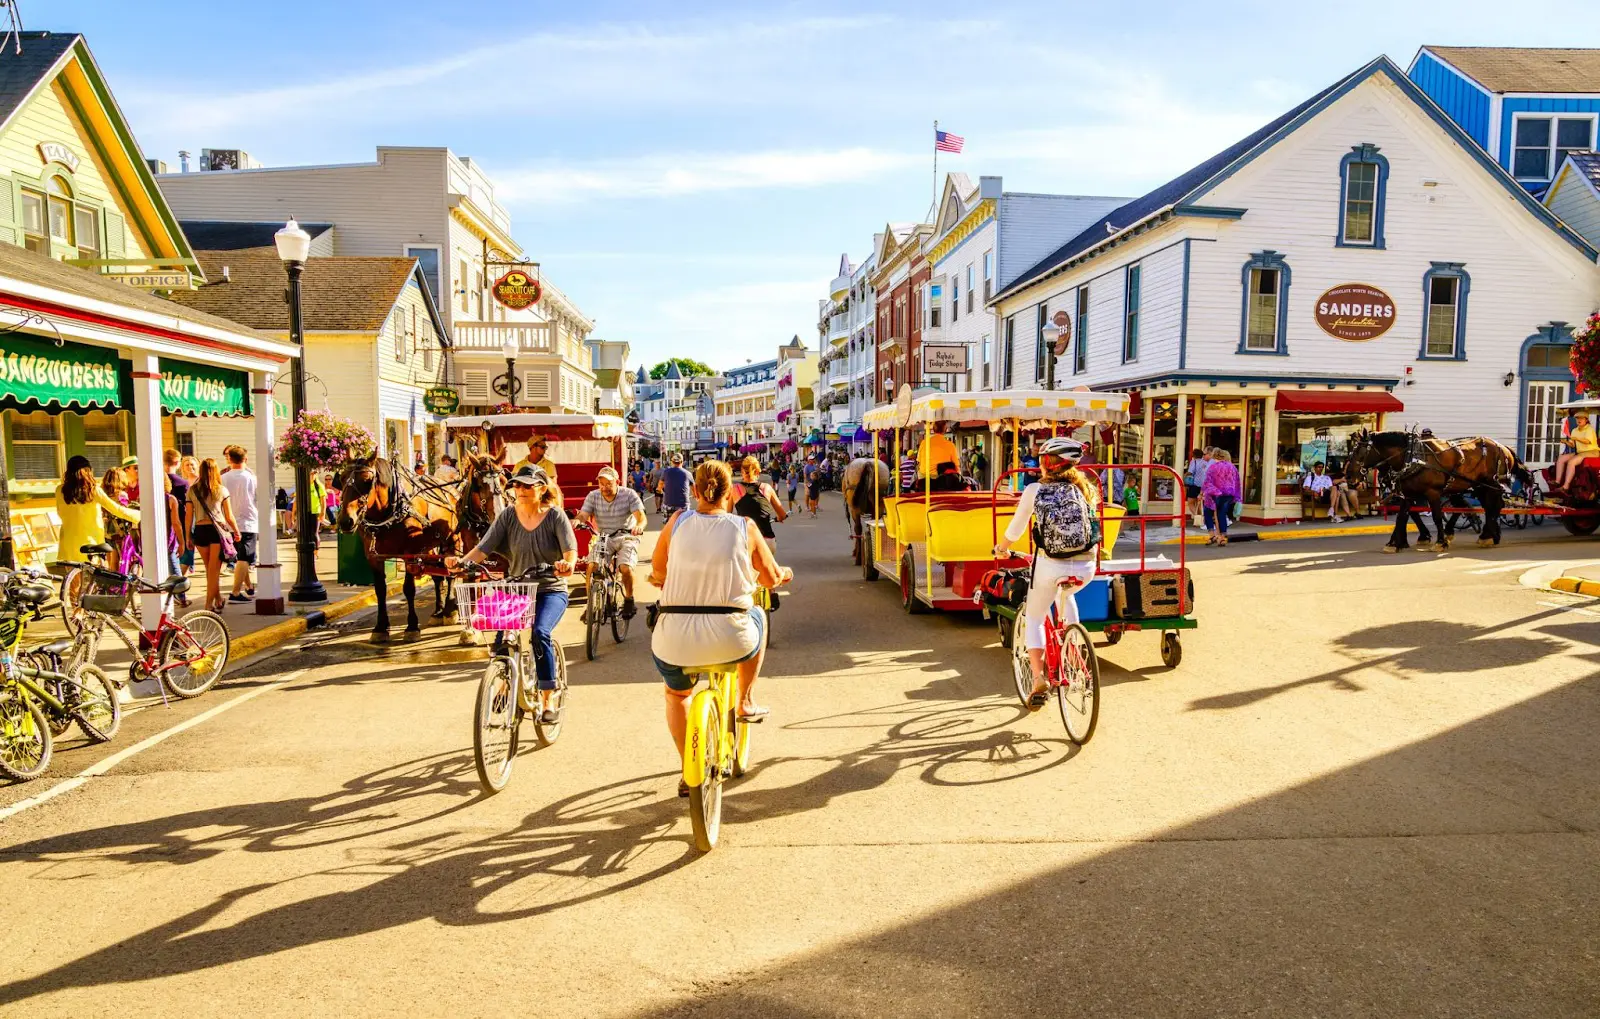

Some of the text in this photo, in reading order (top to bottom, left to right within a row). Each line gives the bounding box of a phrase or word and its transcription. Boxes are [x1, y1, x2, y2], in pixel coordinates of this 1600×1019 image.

[44, 145, 76, 166] TAXI
[129, 275, 185, 286] OFFICE
[1328, 288, 1351, 297] CHOCOLATE
[1319, 302, 1393, 318] SANDERS
[945, 360, 963, 369] Shops
[162, 371, 227, 402] HOT DOGS
